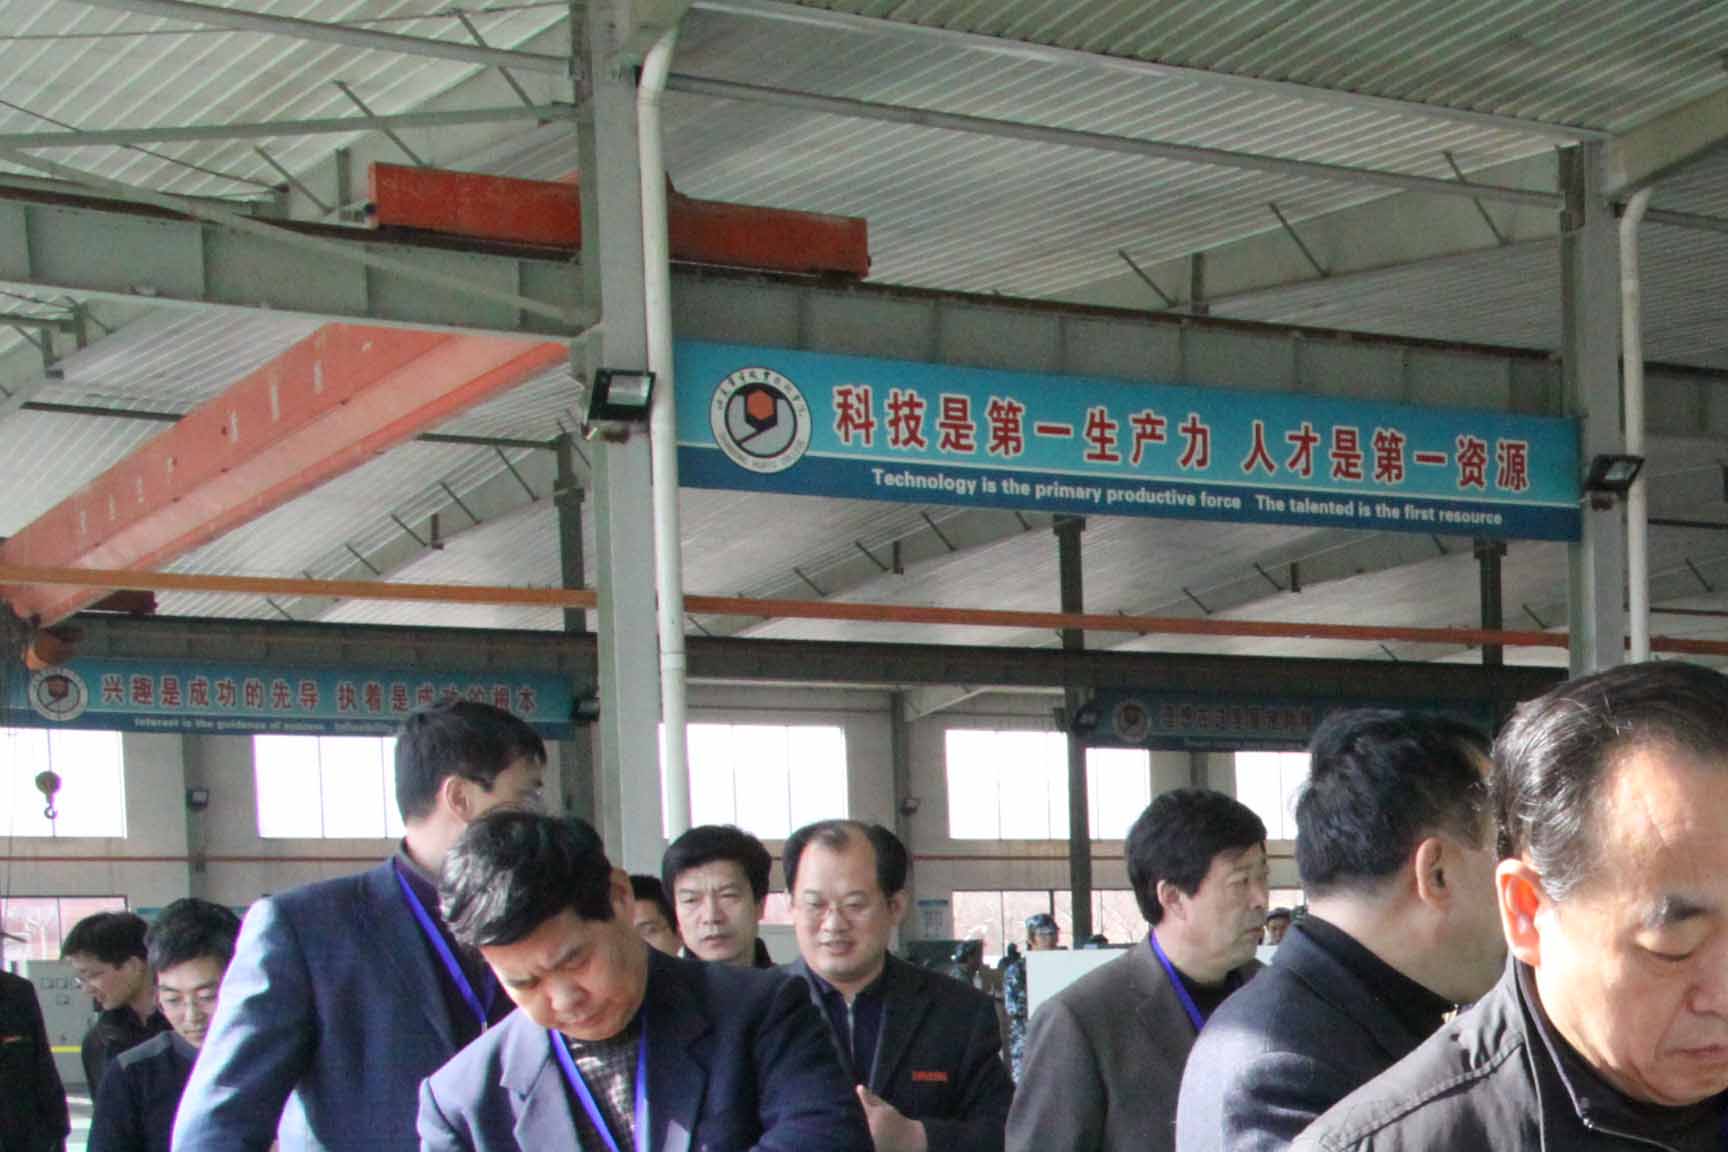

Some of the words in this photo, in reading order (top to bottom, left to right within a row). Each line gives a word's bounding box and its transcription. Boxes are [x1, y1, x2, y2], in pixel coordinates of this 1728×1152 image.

[831, 383, 1213, 471] 科技是第一生产力
[1241, 418, 1531, 492] 人才是第一资源
[872, 468, 977, 496] Technology
[982, 476, 997, 493] is
[1002, 477, 1031, 497] the
[1035, 481, 1102, 503] primary
[1106, 487, 1197, 507] productive
[1200, 491, 1241, 509] force
[1255, 494, 1285, 512] The
[1289, 497, 1354, 517] talented
[1358, 500, 1372, 517] is
[1375, 503, 1400, 520] the
[1404, 504, 1435, 522] first
[1439, 509, 1503, 525] resource
[102, 672, 319, 711] 兴趣是成功的先导
